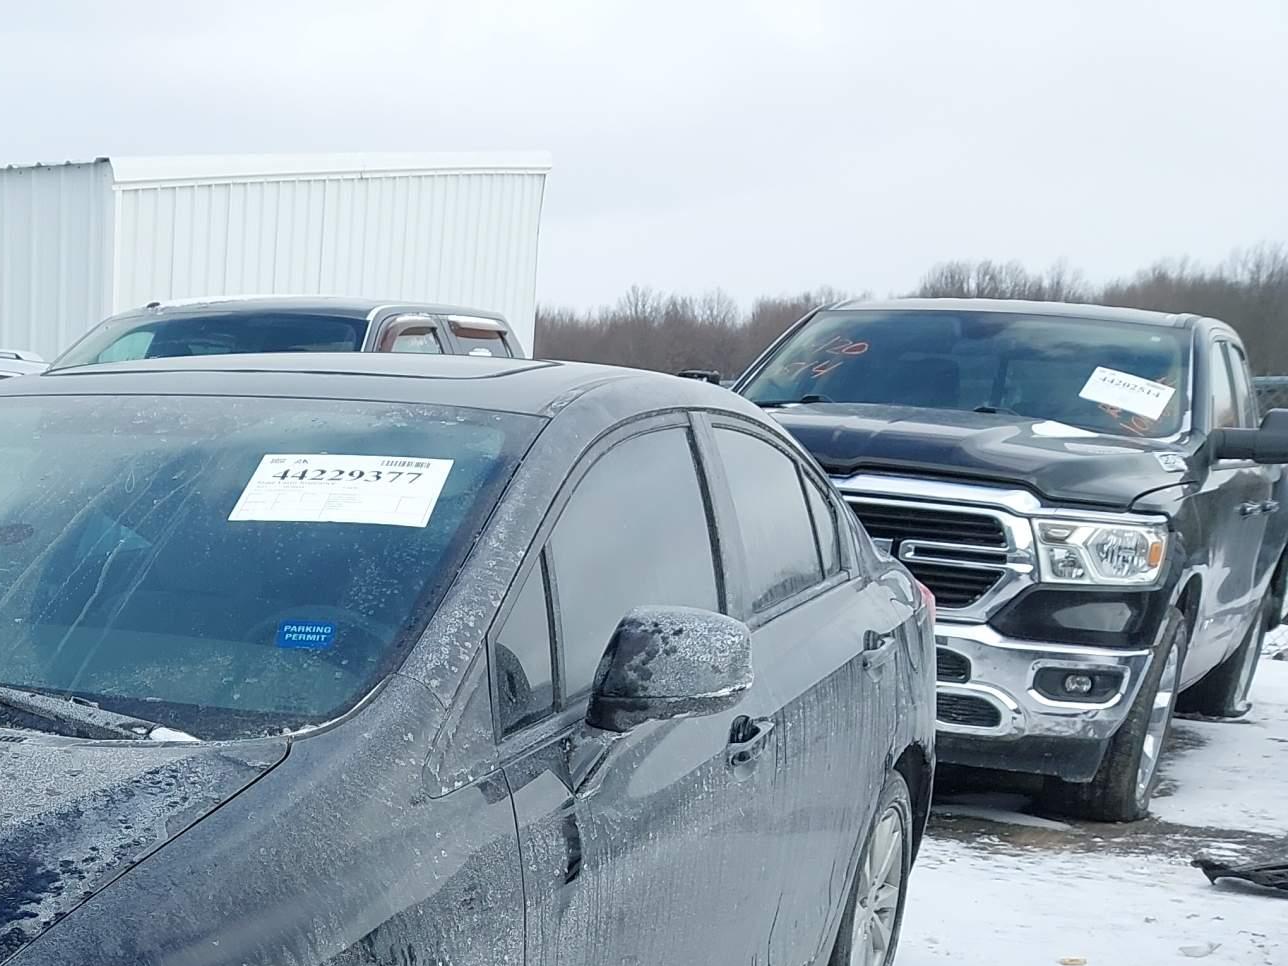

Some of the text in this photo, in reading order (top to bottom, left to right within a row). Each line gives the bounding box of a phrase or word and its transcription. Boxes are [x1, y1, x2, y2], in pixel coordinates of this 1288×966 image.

[272, 468, 423, 485] 44229377
[283, 625, 332, 634] PARKING
[284, 633, 328, 641] PERMIT
